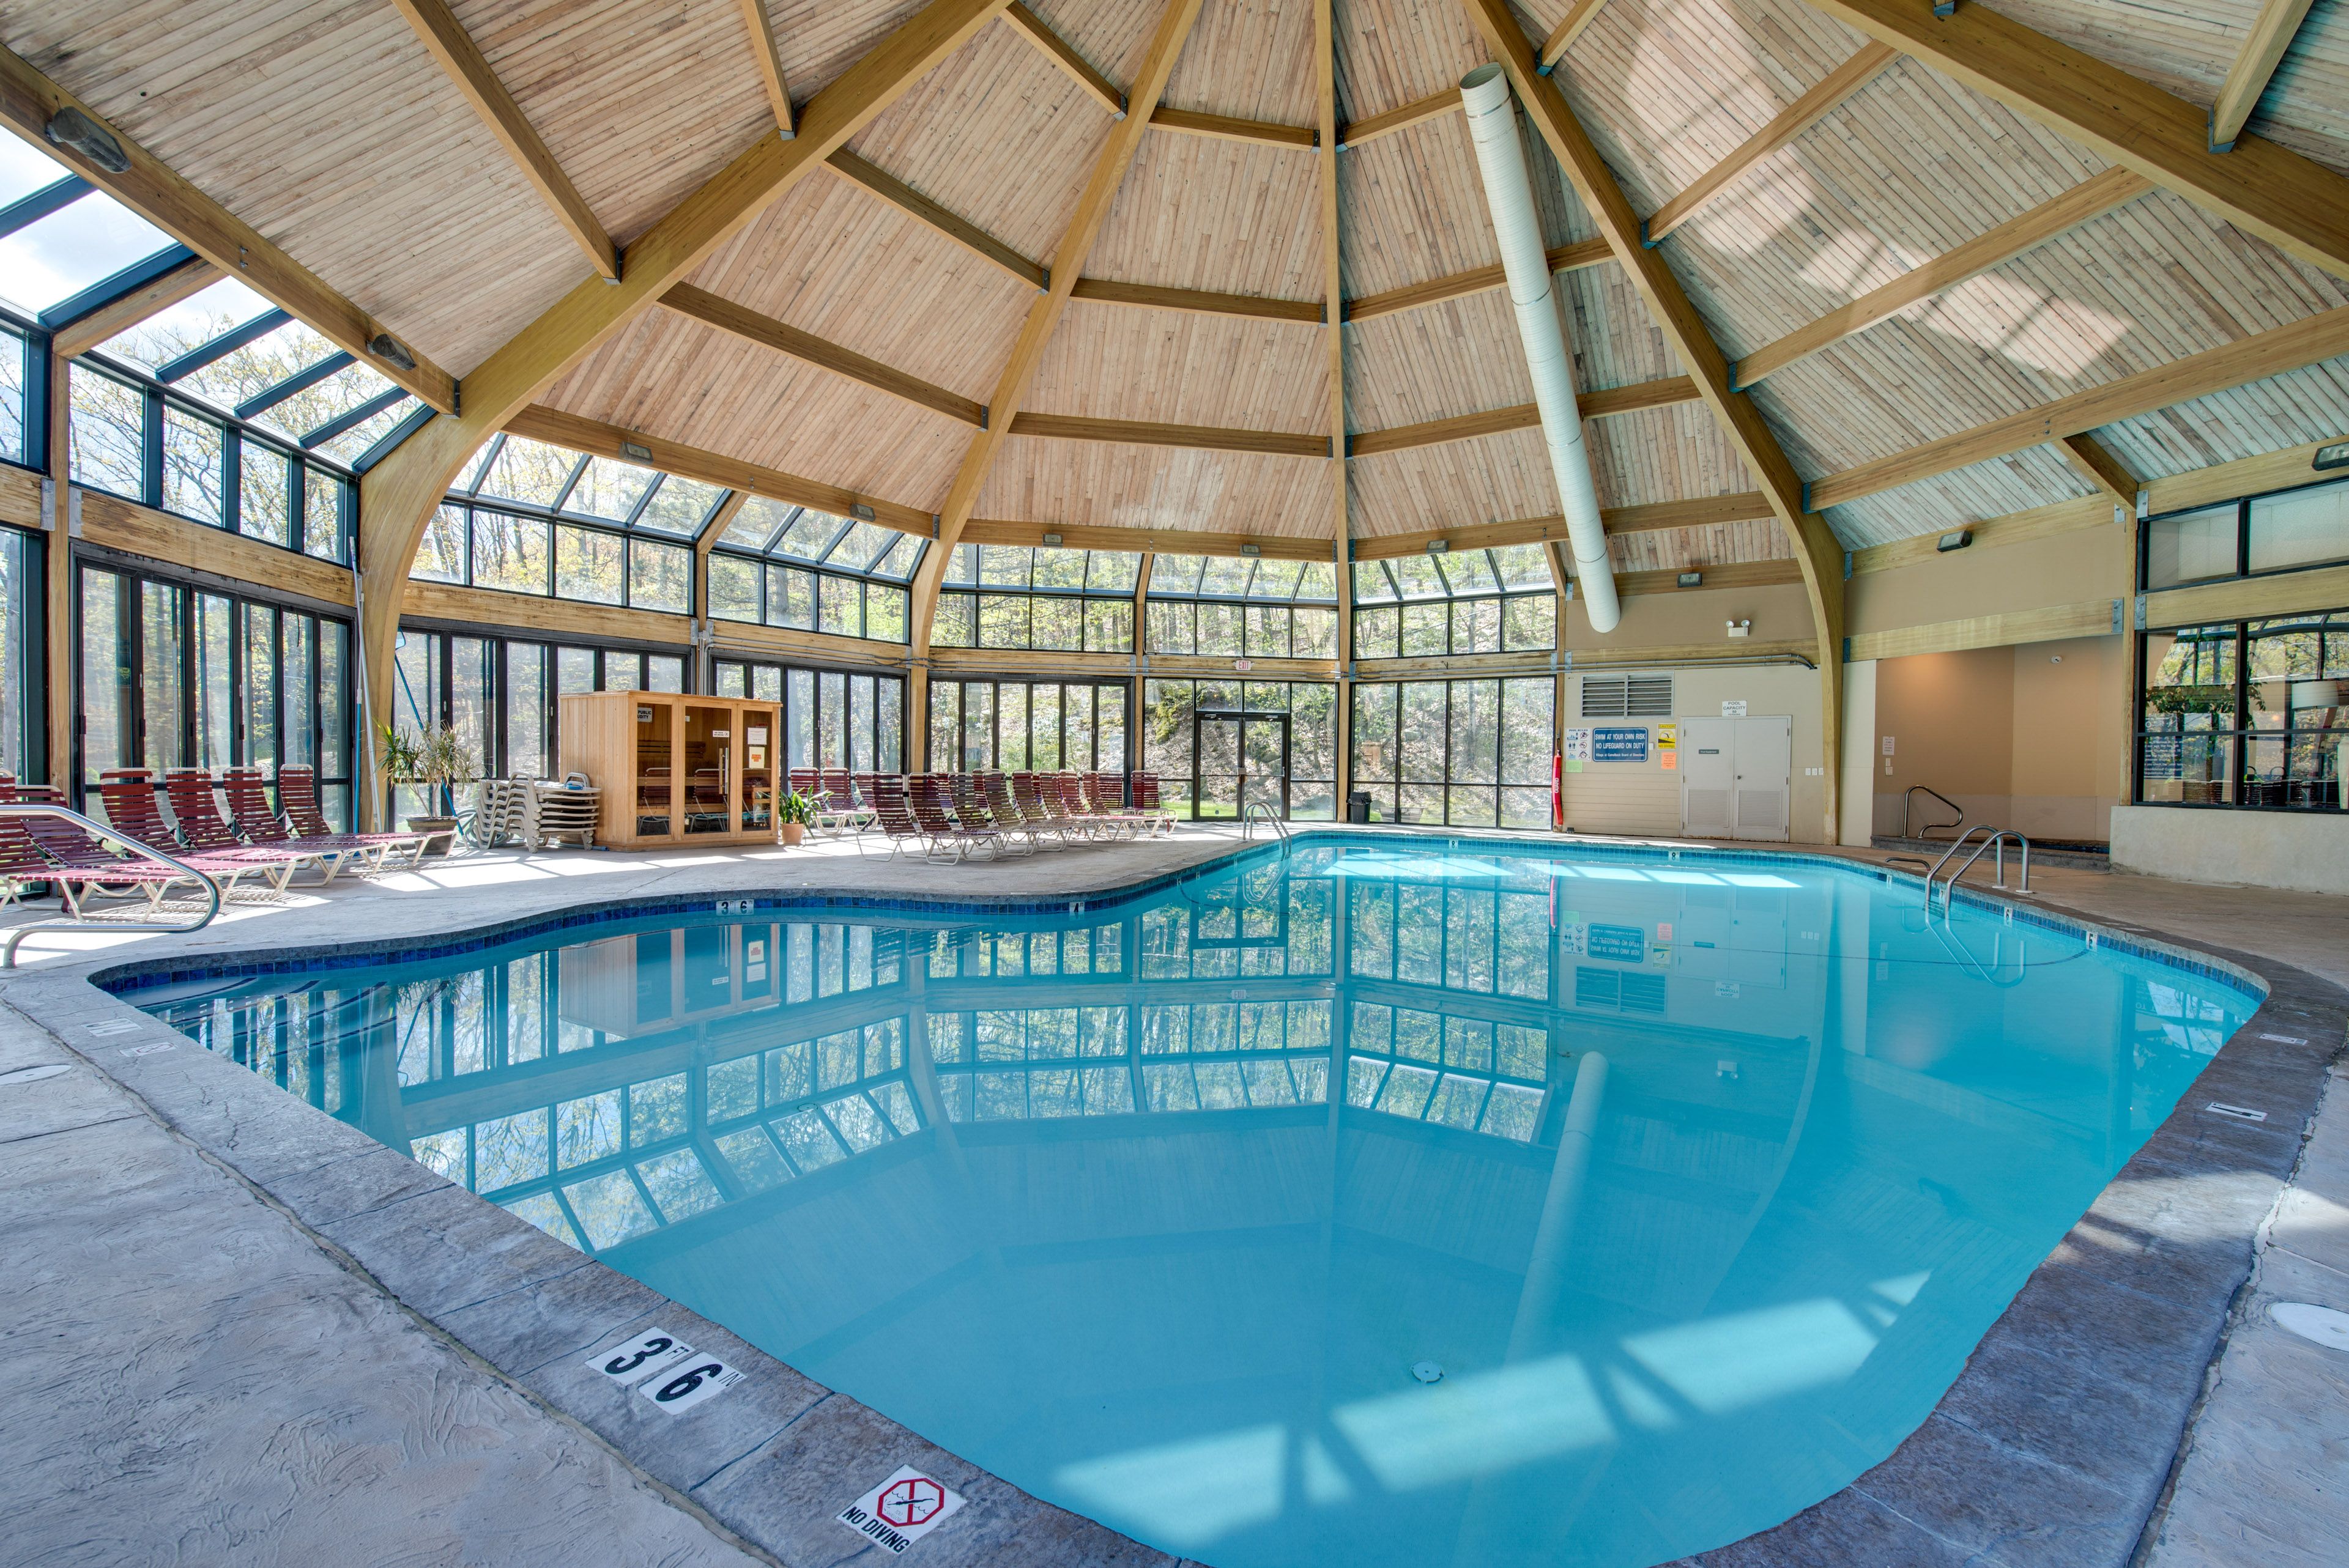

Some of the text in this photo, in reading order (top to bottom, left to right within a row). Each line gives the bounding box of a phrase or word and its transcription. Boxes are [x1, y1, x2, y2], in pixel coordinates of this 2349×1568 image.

[604, 1337, 690, 1374] 3 FT
[655, 1364, 744, 1402] 6 IN
[842, 1506, 910, 1554] NO DIVING
